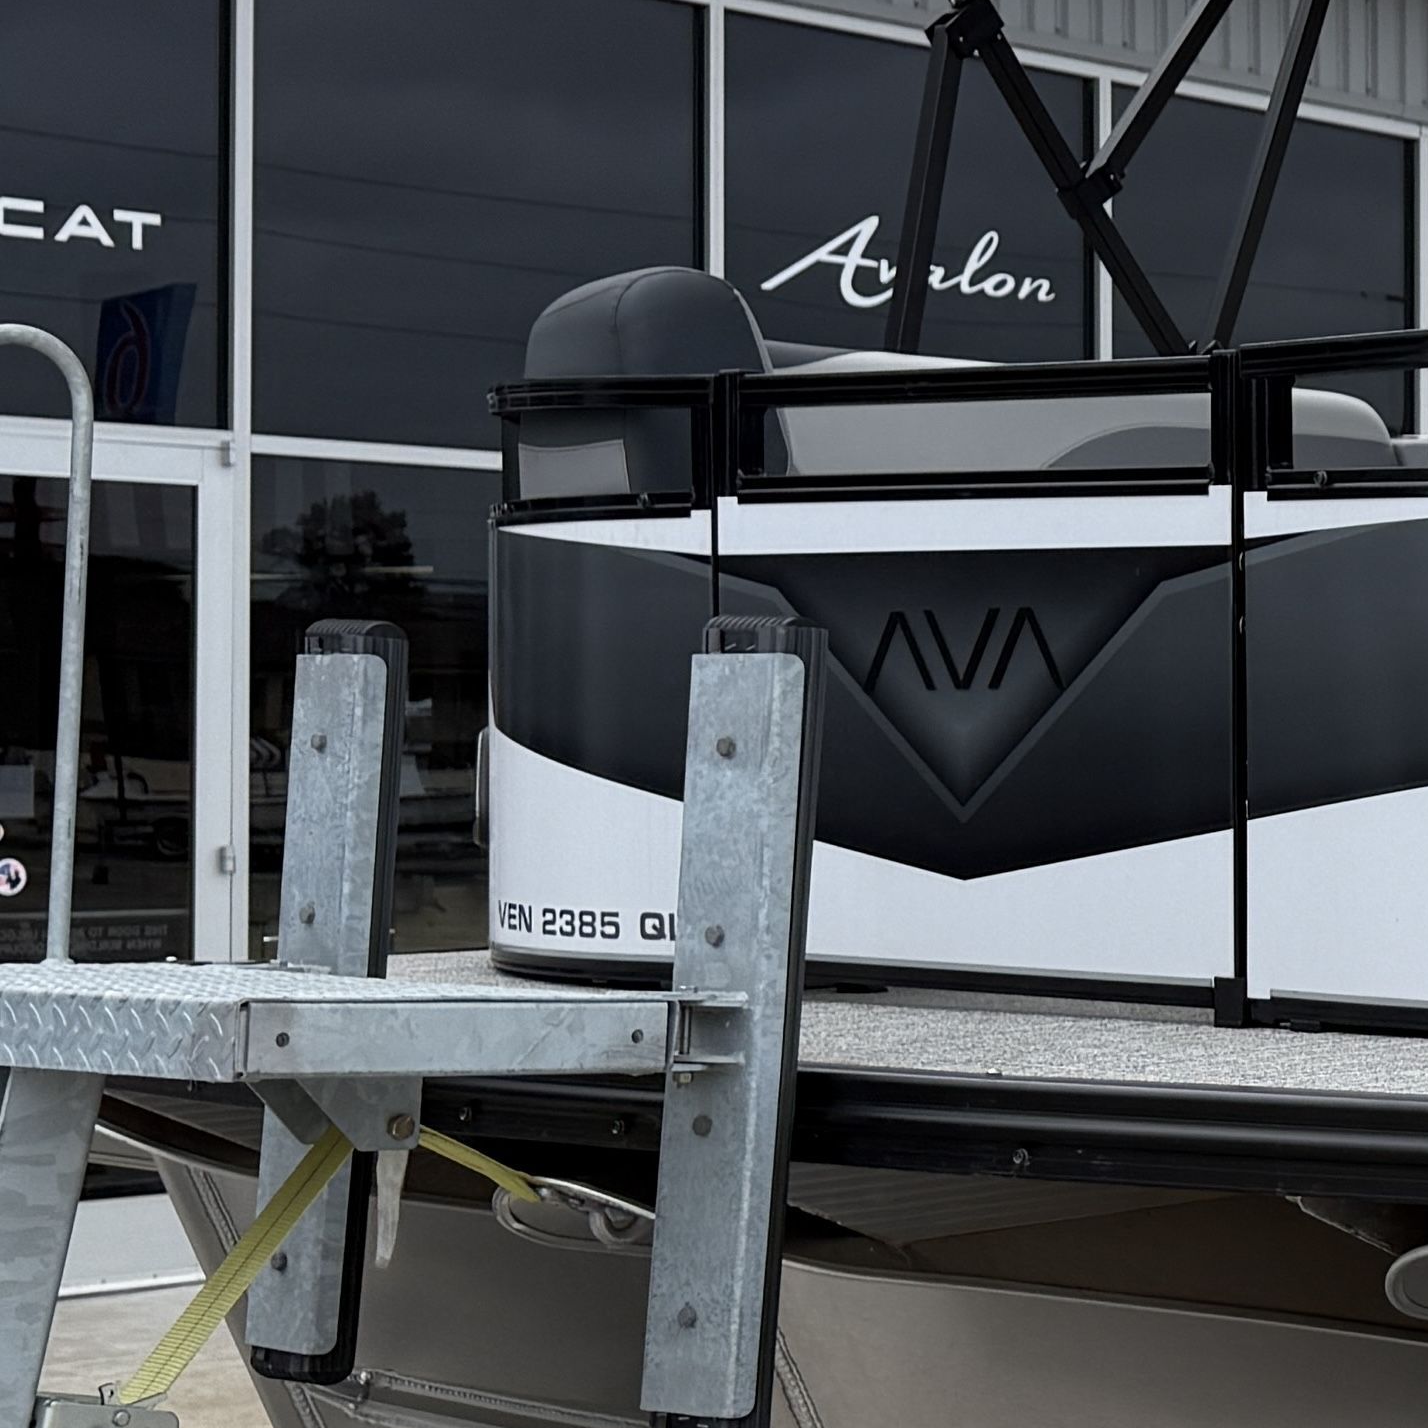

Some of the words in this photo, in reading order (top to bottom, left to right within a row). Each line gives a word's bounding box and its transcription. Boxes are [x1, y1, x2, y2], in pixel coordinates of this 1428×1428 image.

[0, 196, 162, 251] CAT
[862, 606, 1069, 696] AVA
[542, 907, 620, 940] 2385
